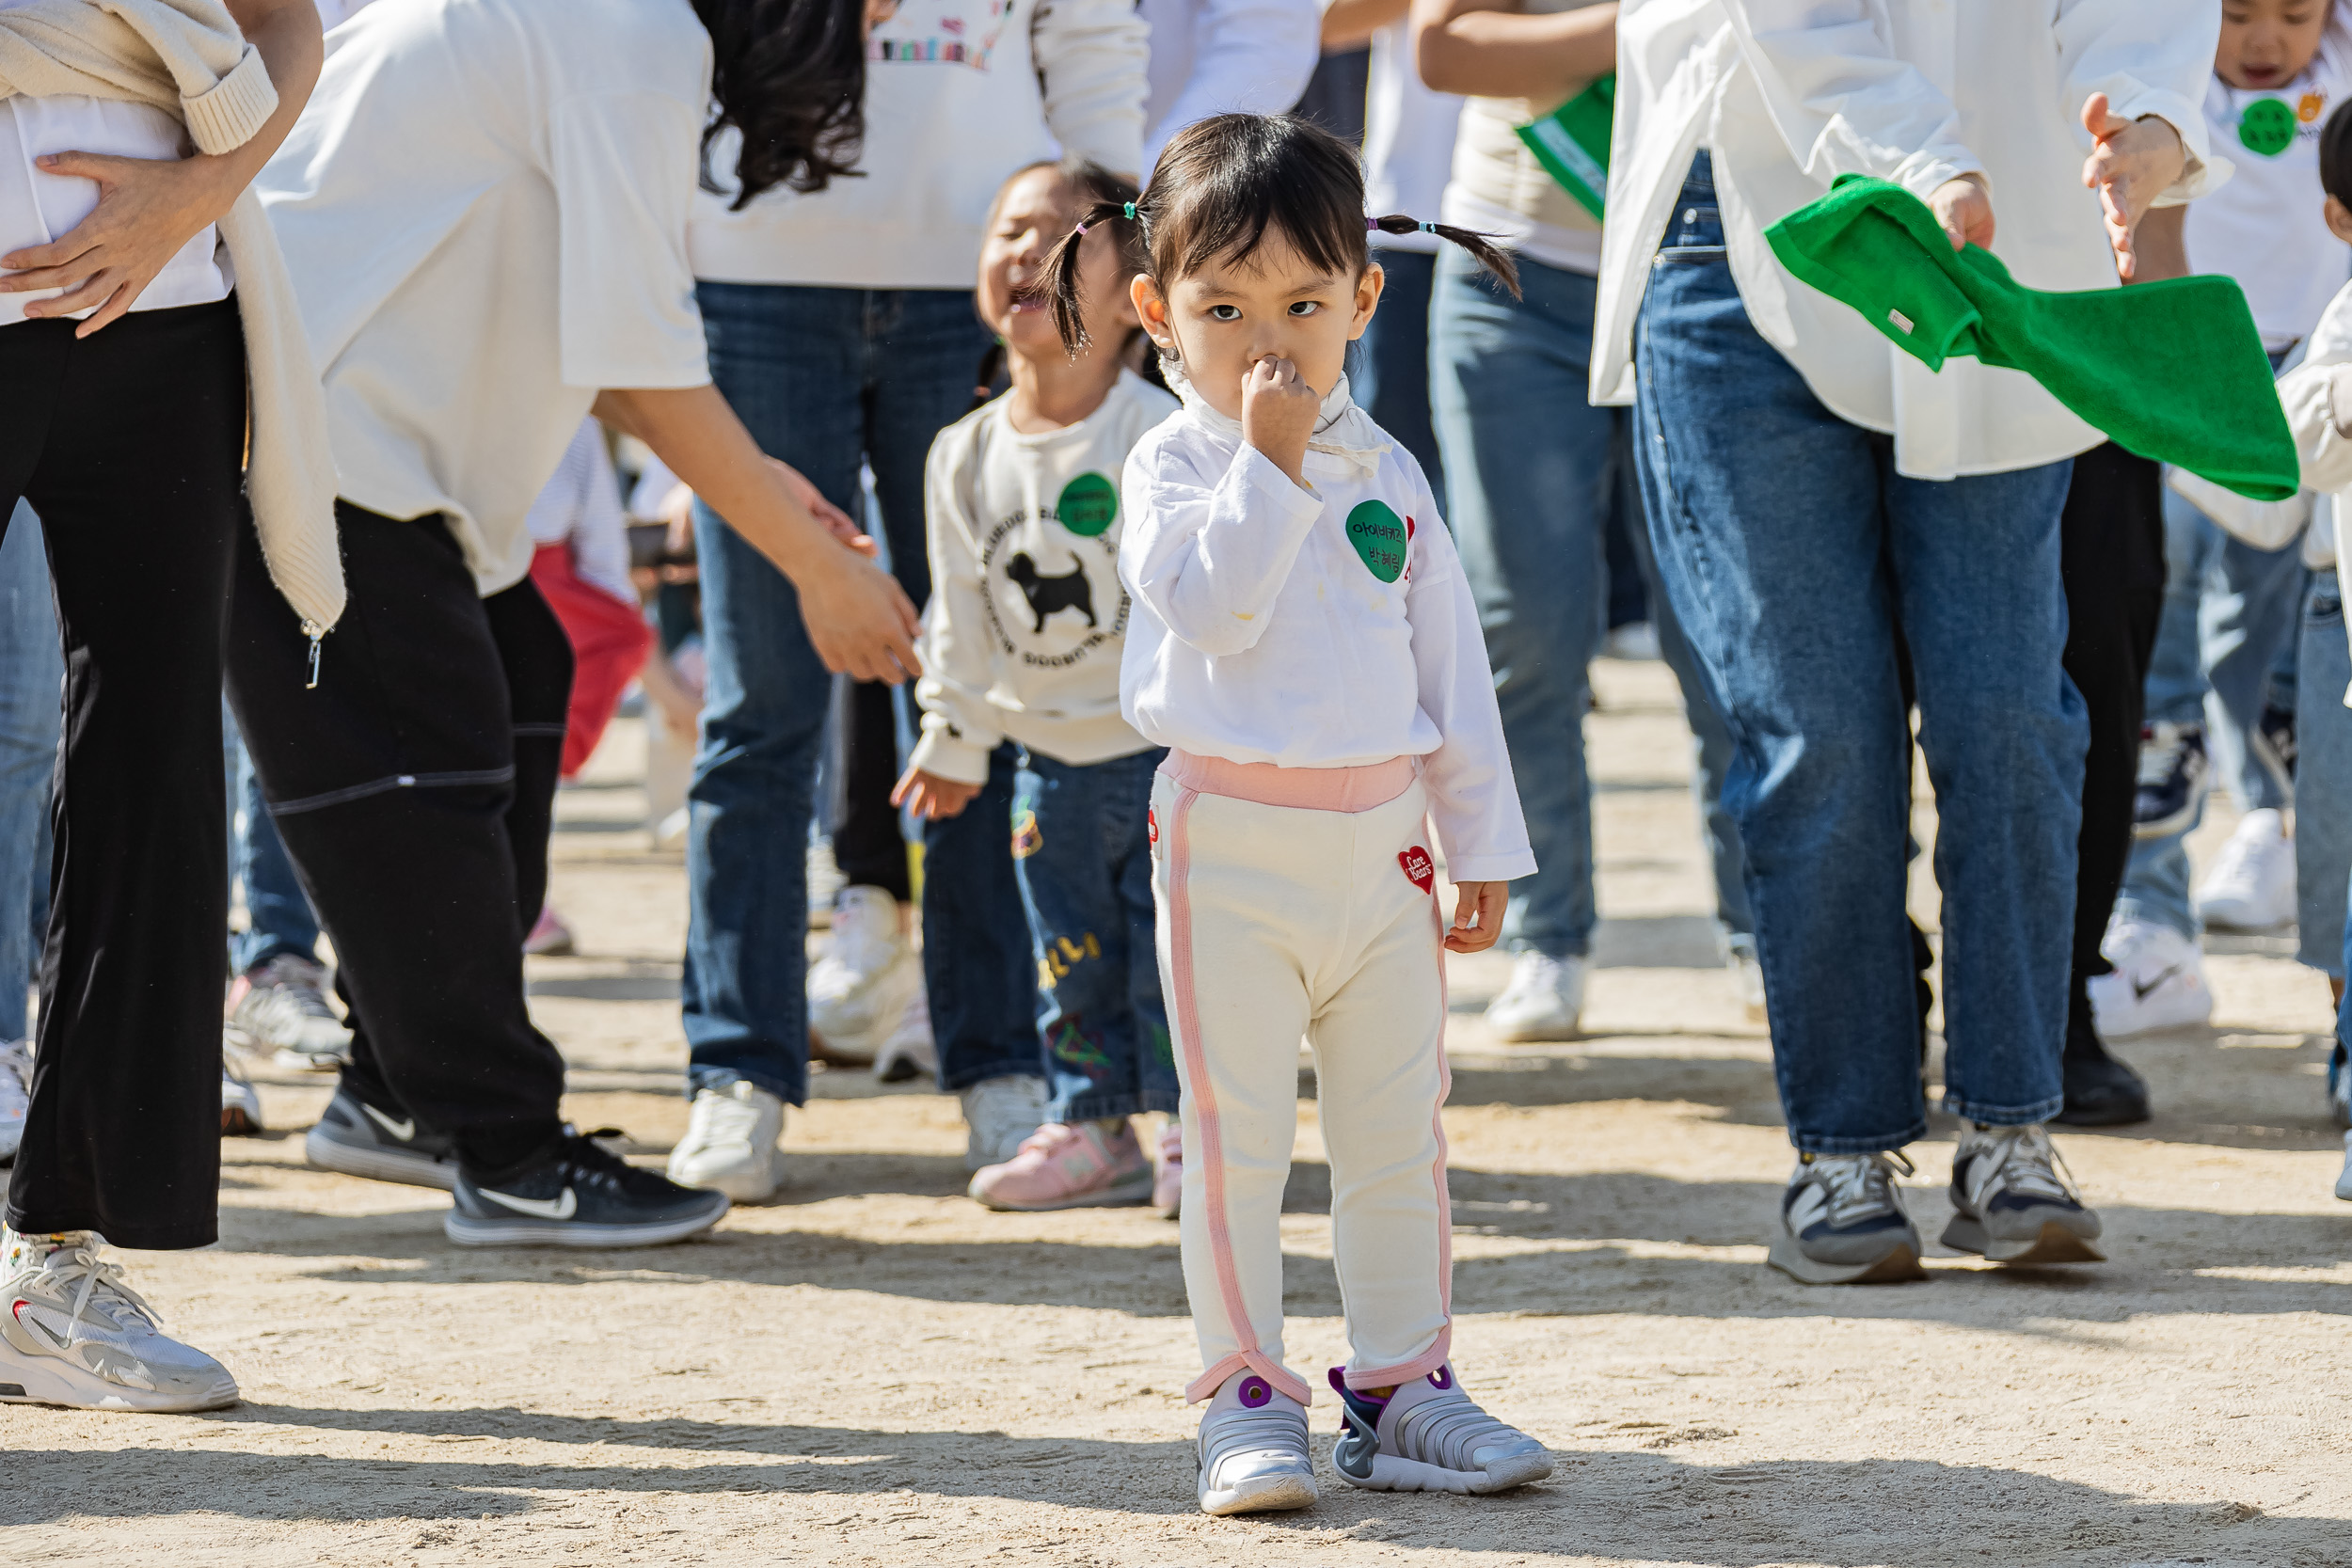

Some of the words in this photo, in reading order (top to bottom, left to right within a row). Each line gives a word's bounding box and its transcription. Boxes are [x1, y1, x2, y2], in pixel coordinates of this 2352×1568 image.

[1353, 521, 1403, 544] 아이비키즈
[1406, 856, 1425, 868] Care
[1408, 863, 1431, 880] Bears
